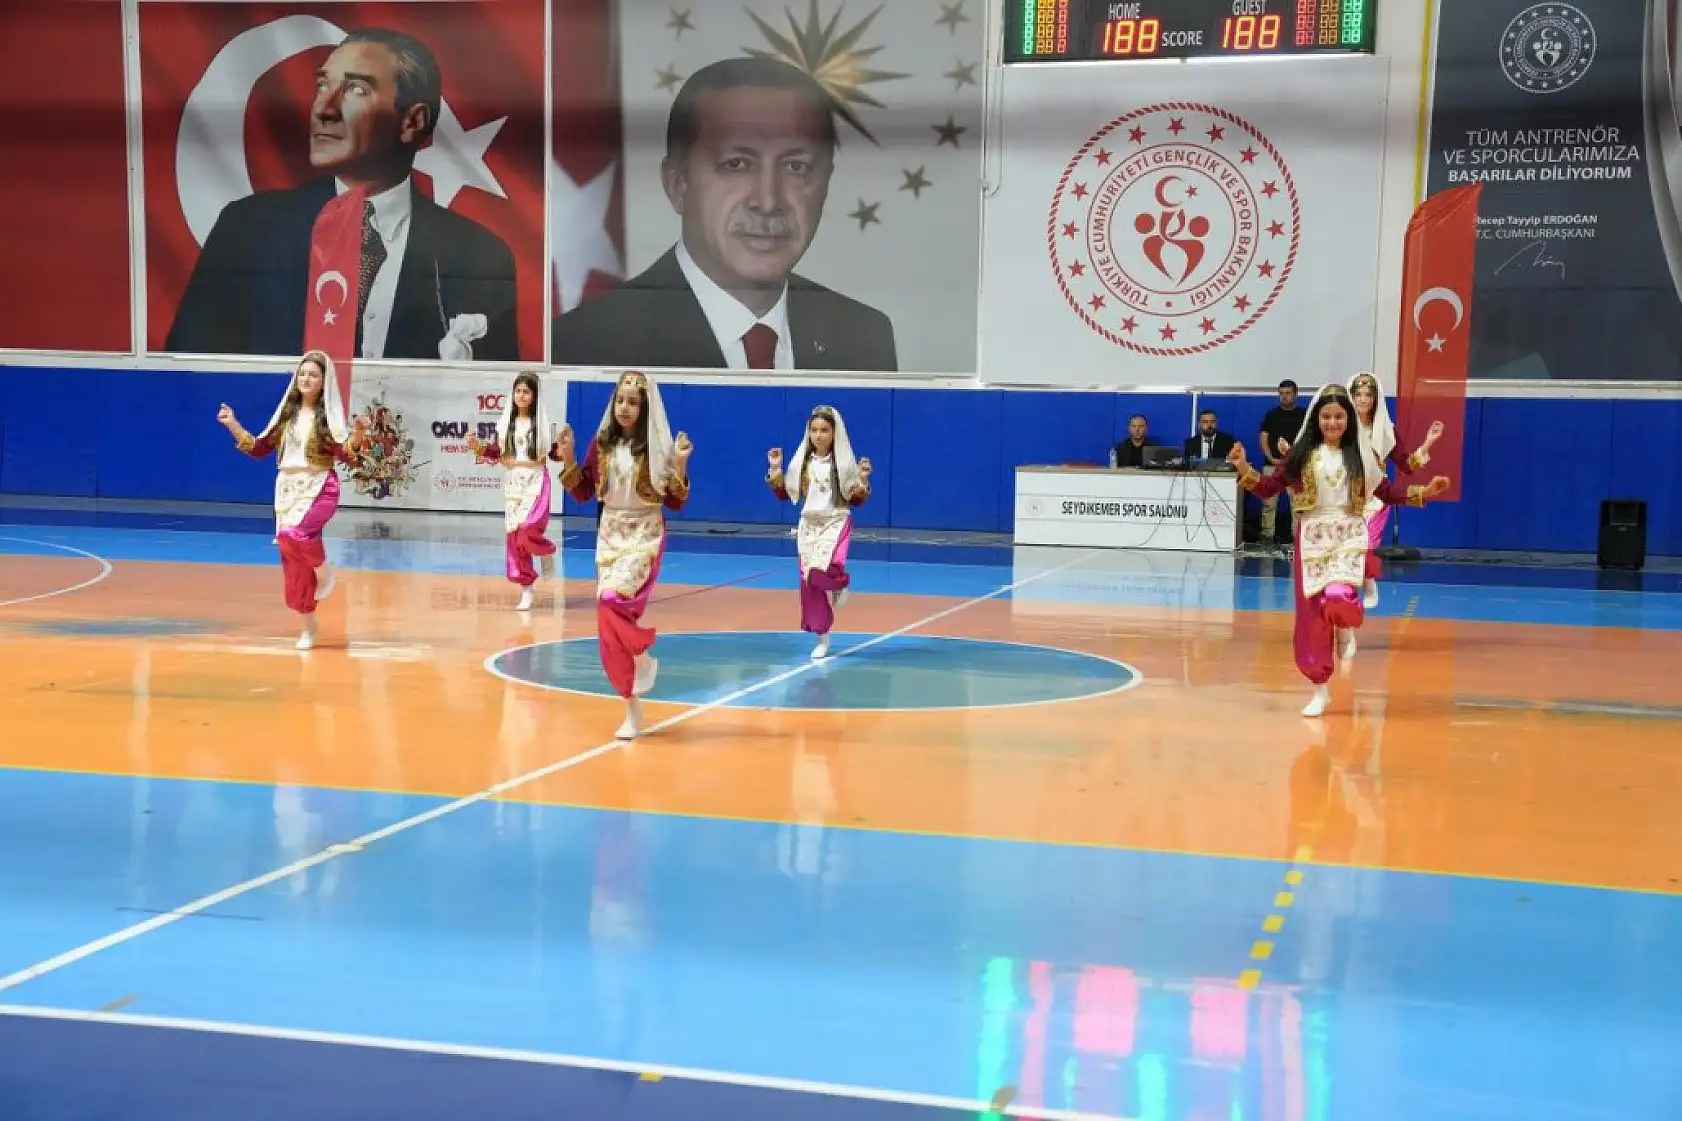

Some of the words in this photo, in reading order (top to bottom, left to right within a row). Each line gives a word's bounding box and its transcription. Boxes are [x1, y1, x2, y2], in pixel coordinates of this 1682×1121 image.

[1107, 2, 1140, 20] HOME
[1232, 0, 1266, 16] GUEST
[1104, 19, 1160, 53] 188
[1161, 30, 1204, 47] SCORE
[1222, 14, 1281, 50] 188
[1466, 128, 1508, 146] TÜM
[1513, 126, 1619, 145] ANTRENÖR
[1153, 149, 1220, 173] GENÇLİK
[1443, 150, 1466, 165] VE
[1470, 145, 1640, 164] SPORCULARIMIZA
[1221, 169, 1239, 189] VE
[1448, 167, 1536, 184] BAŞARILAR
[1540, 165, 1632, 181] DİLİYORUM
[1233, 189, 1251, 231] SPOR
[1543, 212, 1598, 225] ERDOĞAN
[1099, 255, 1149, 307] TÜRKİYE
[1189, 236, 1251, 307] BAKANLIĞI
[1123, 503, 1147, 517] SPOR
[1149, 504, 1188, 518] SALONU
